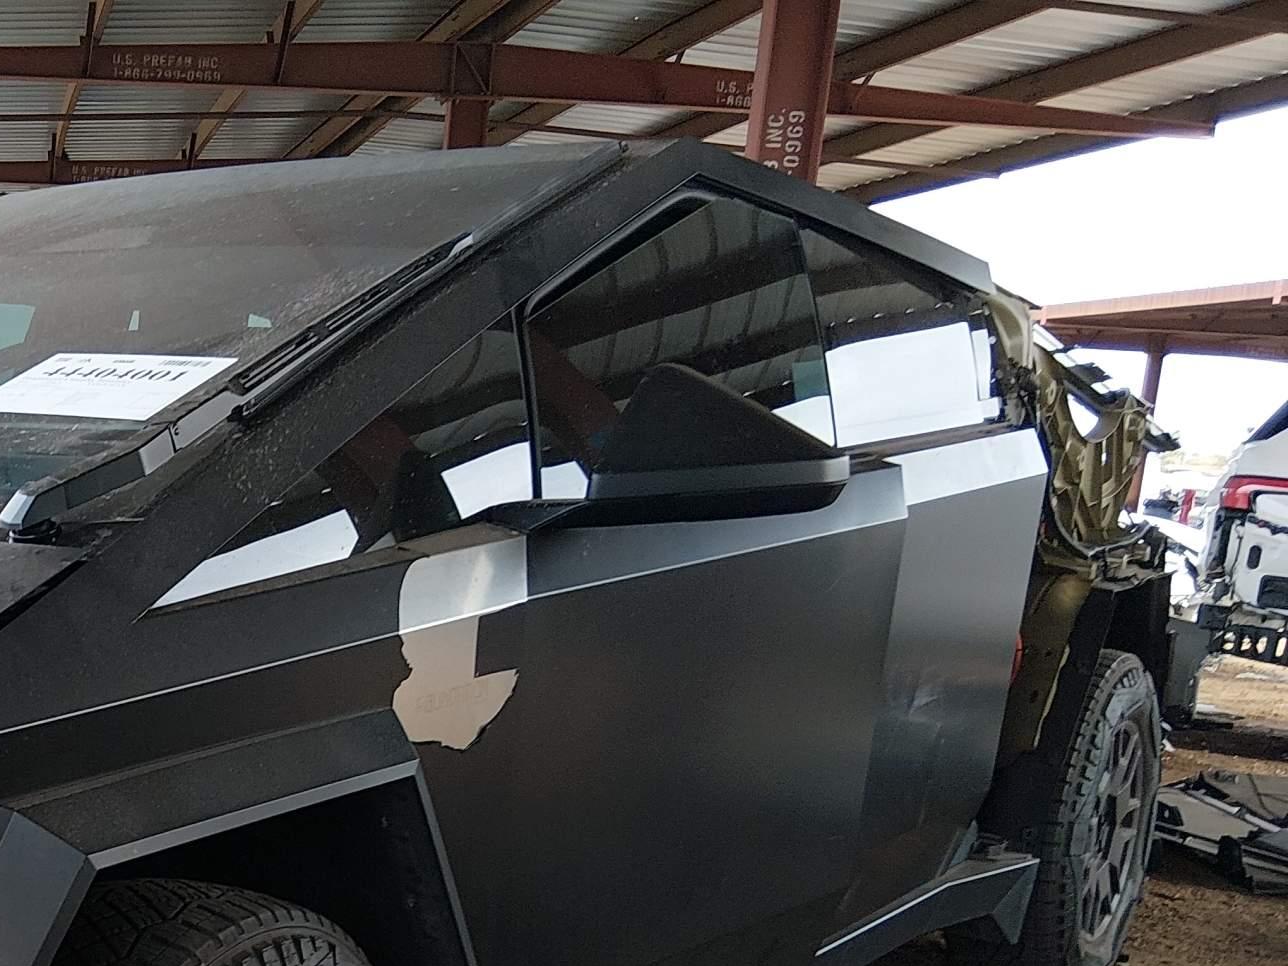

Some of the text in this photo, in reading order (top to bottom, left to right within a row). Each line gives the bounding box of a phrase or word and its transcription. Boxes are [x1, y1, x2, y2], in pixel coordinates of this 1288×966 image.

[113, 53, 136, 66] U.S.
[144, 54, 192, 67] PREFAB
[113, 67, 221, 81] 1-866-799-0969
[716, 80, 740, 94] U.S.
[765, 108, 786, 148] INC.
[43, 366, 189, 382] 44404001
